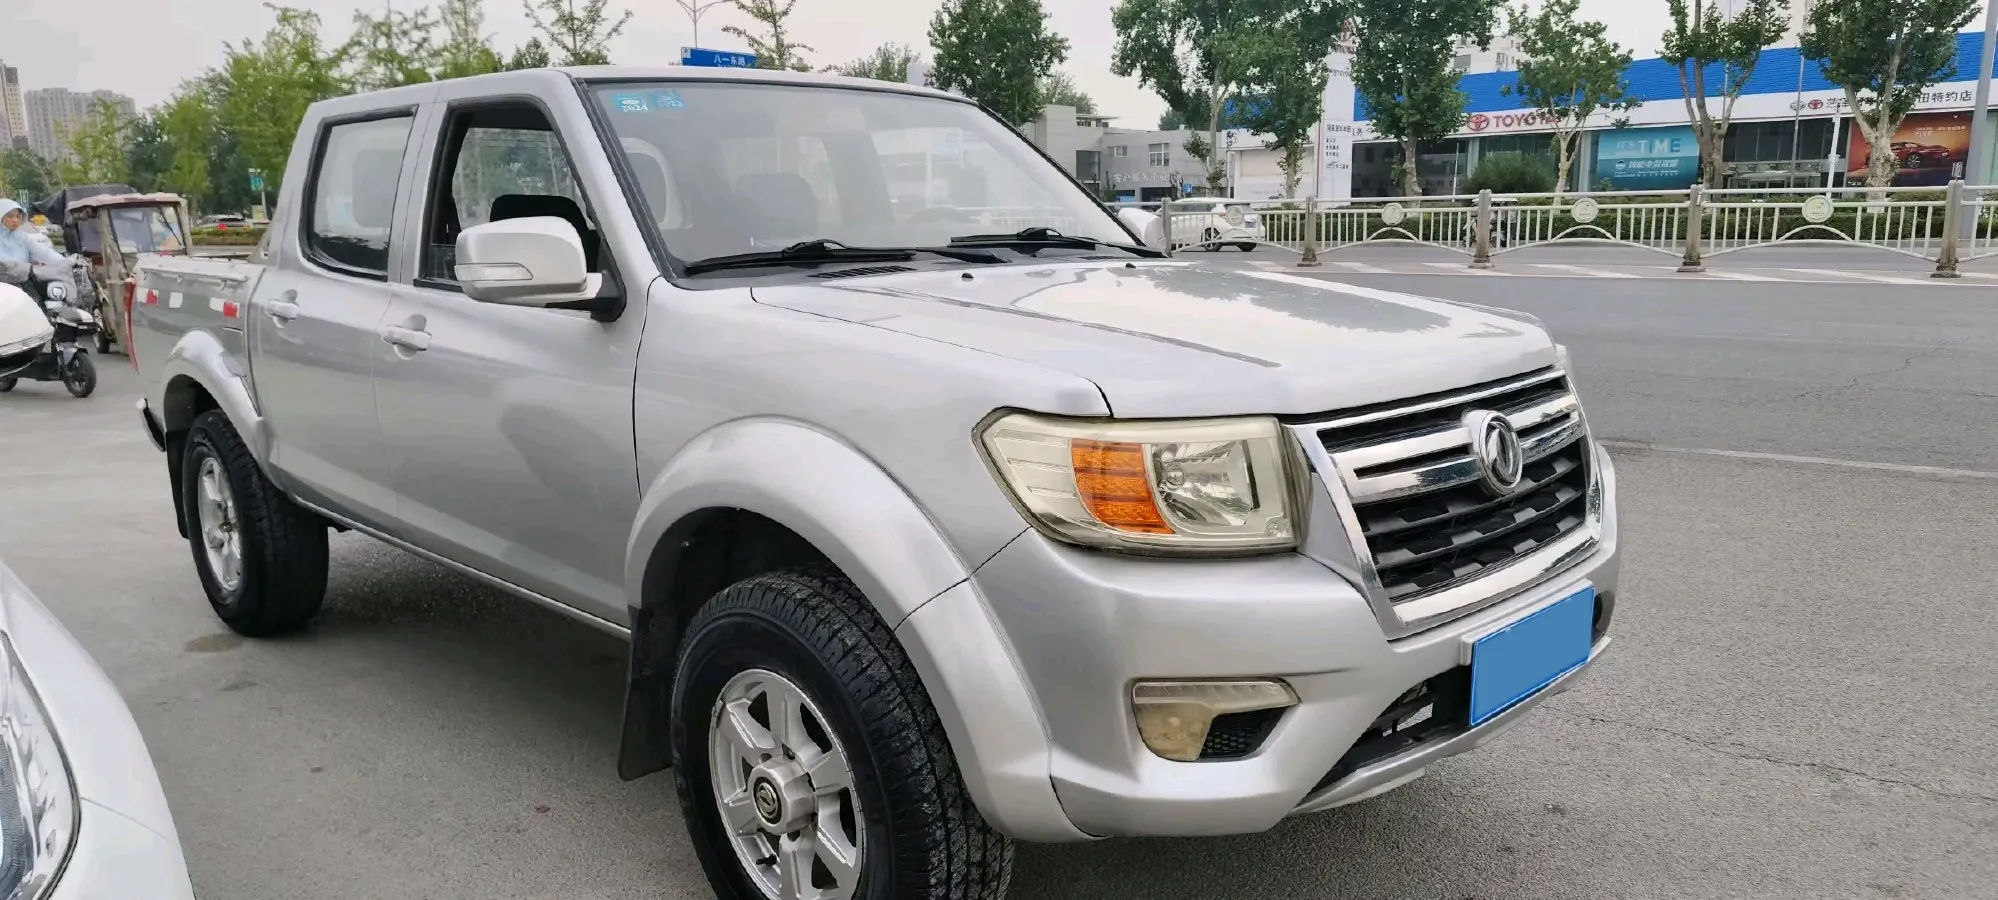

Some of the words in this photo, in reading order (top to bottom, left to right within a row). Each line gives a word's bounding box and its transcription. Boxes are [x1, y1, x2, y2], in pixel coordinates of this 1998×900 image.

[714, 54, 746, 66] 八一东路
[1638, 138, 1681, 154] TIME
